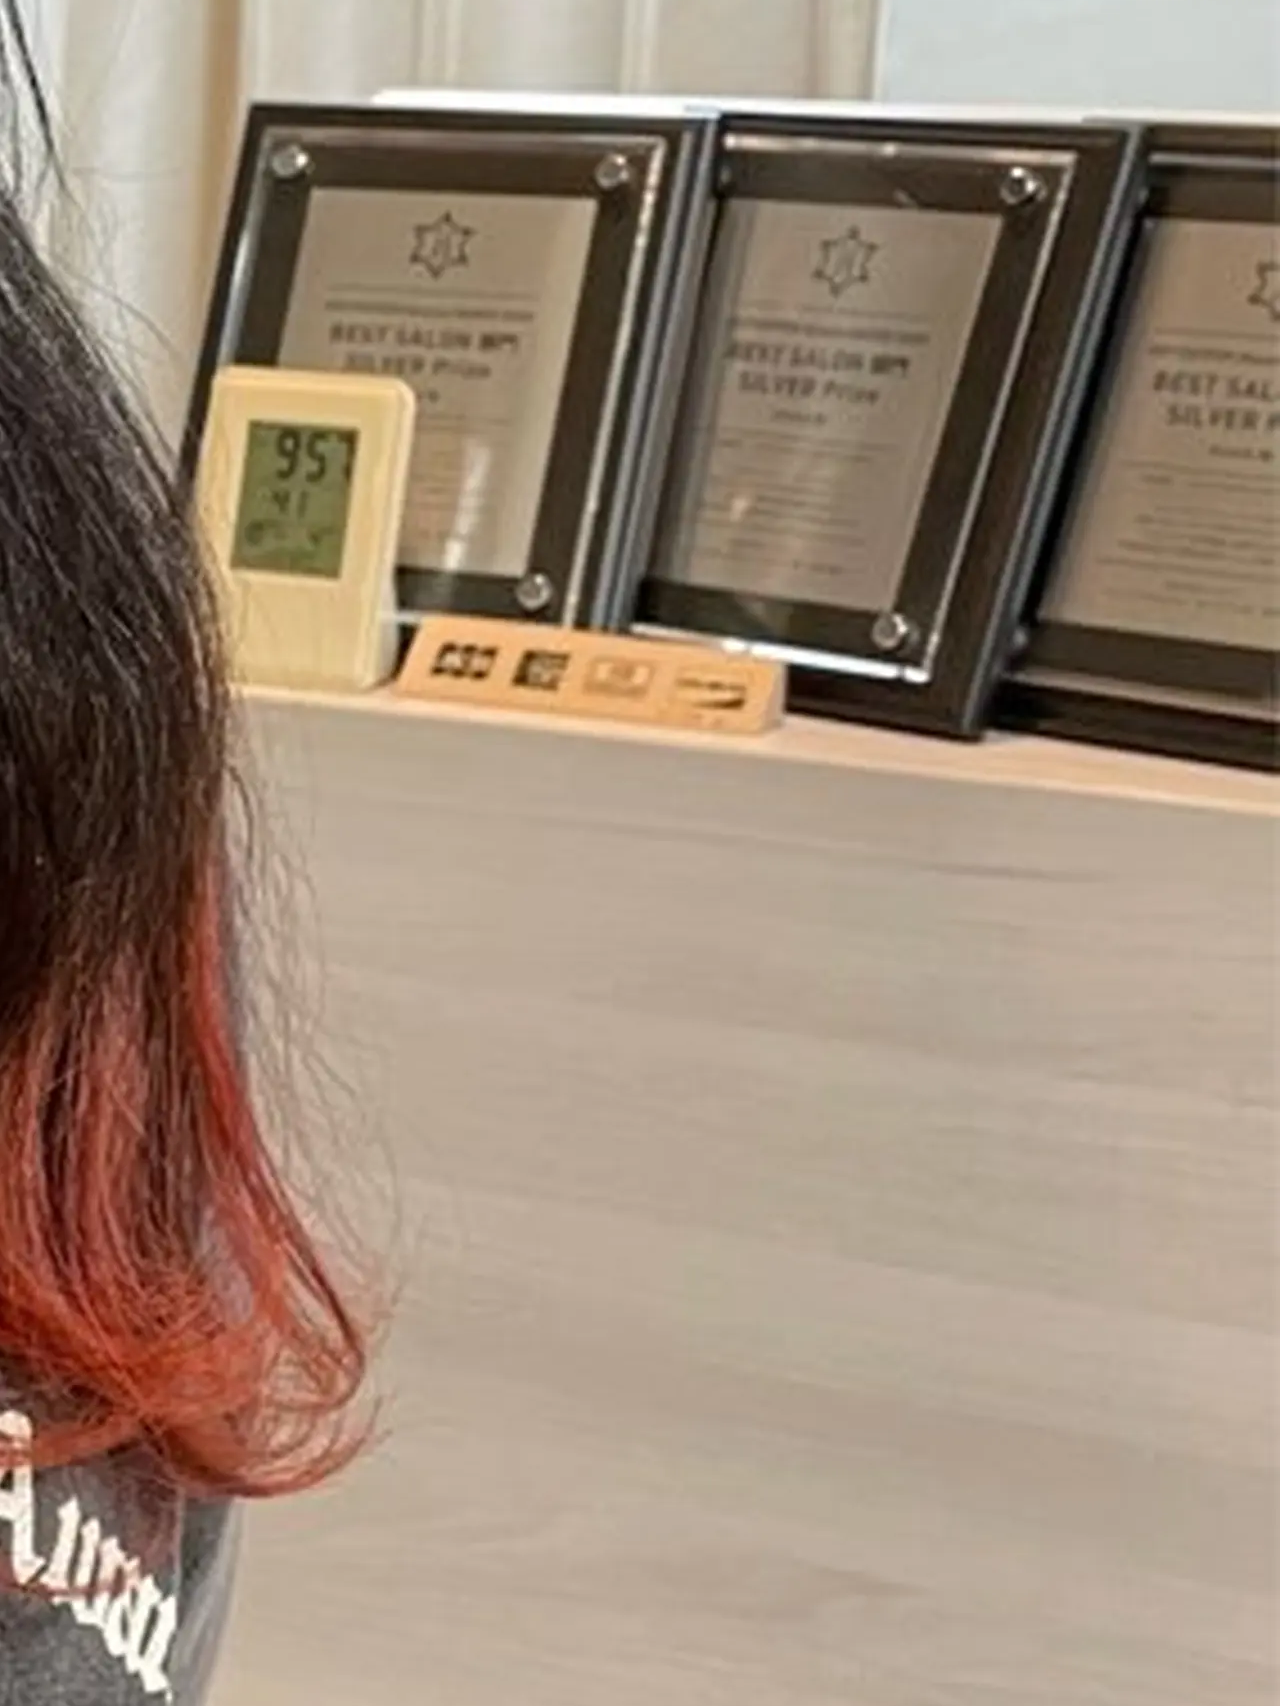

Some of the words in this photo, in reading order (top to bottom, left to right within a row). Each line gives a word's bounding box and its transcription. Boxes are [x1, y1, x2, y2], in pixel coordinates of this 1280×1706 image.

[330, 322, 390, 345] BEST
[396, 326, 472, 351] SALON
[723, 342, 786, 366] BEST
[790, 344, 864, 372] SALON
[738, 370, 817, 398] SILVER
[1153, 369, 1219, 399] BEST
[1226, 376, 1280, 401] SAL
[1165, 403, 1260, 431] SILVER
